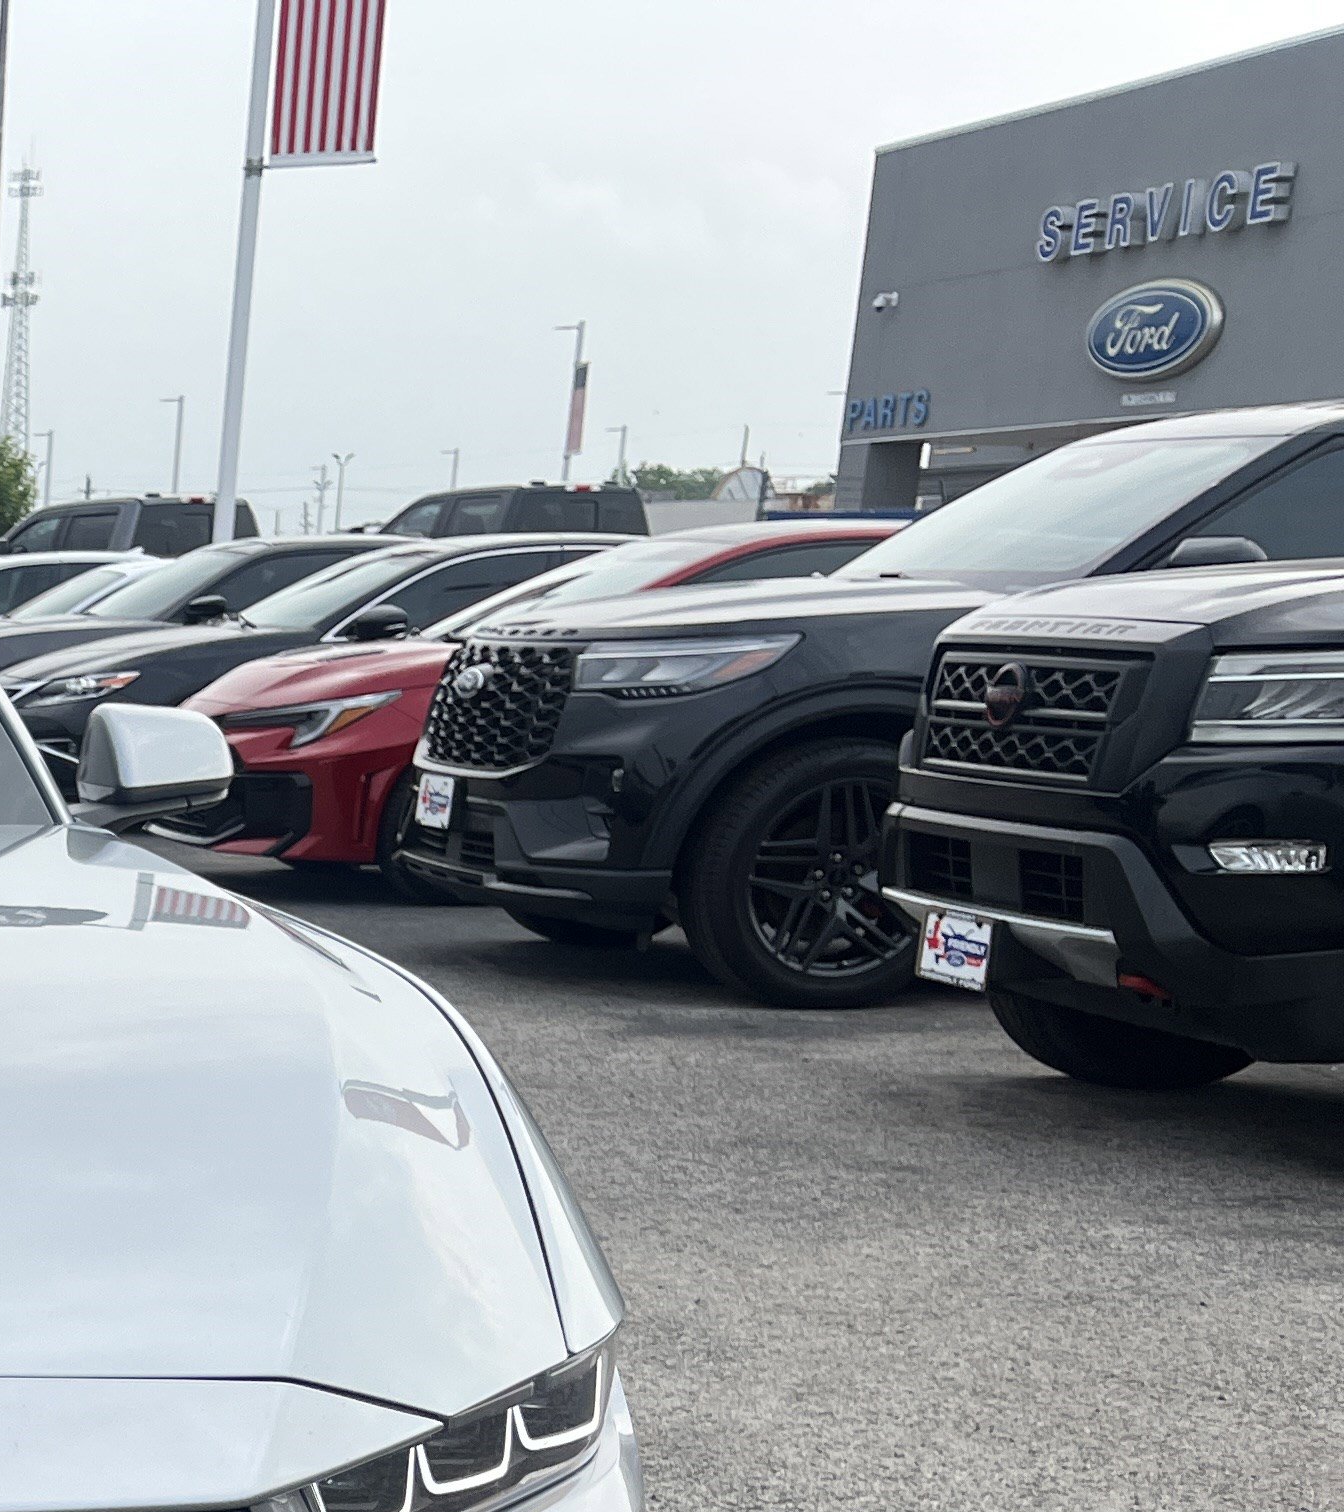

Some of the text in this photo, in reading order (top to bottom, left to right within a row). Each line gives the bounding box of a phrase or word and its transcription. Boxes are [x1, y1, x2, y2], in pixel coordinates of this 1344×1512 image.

[1036, 160, 1288, 263] SERVICE
[1105, 302, 1181, 358] Ford
[847, 388, 931, 433] PARTS
